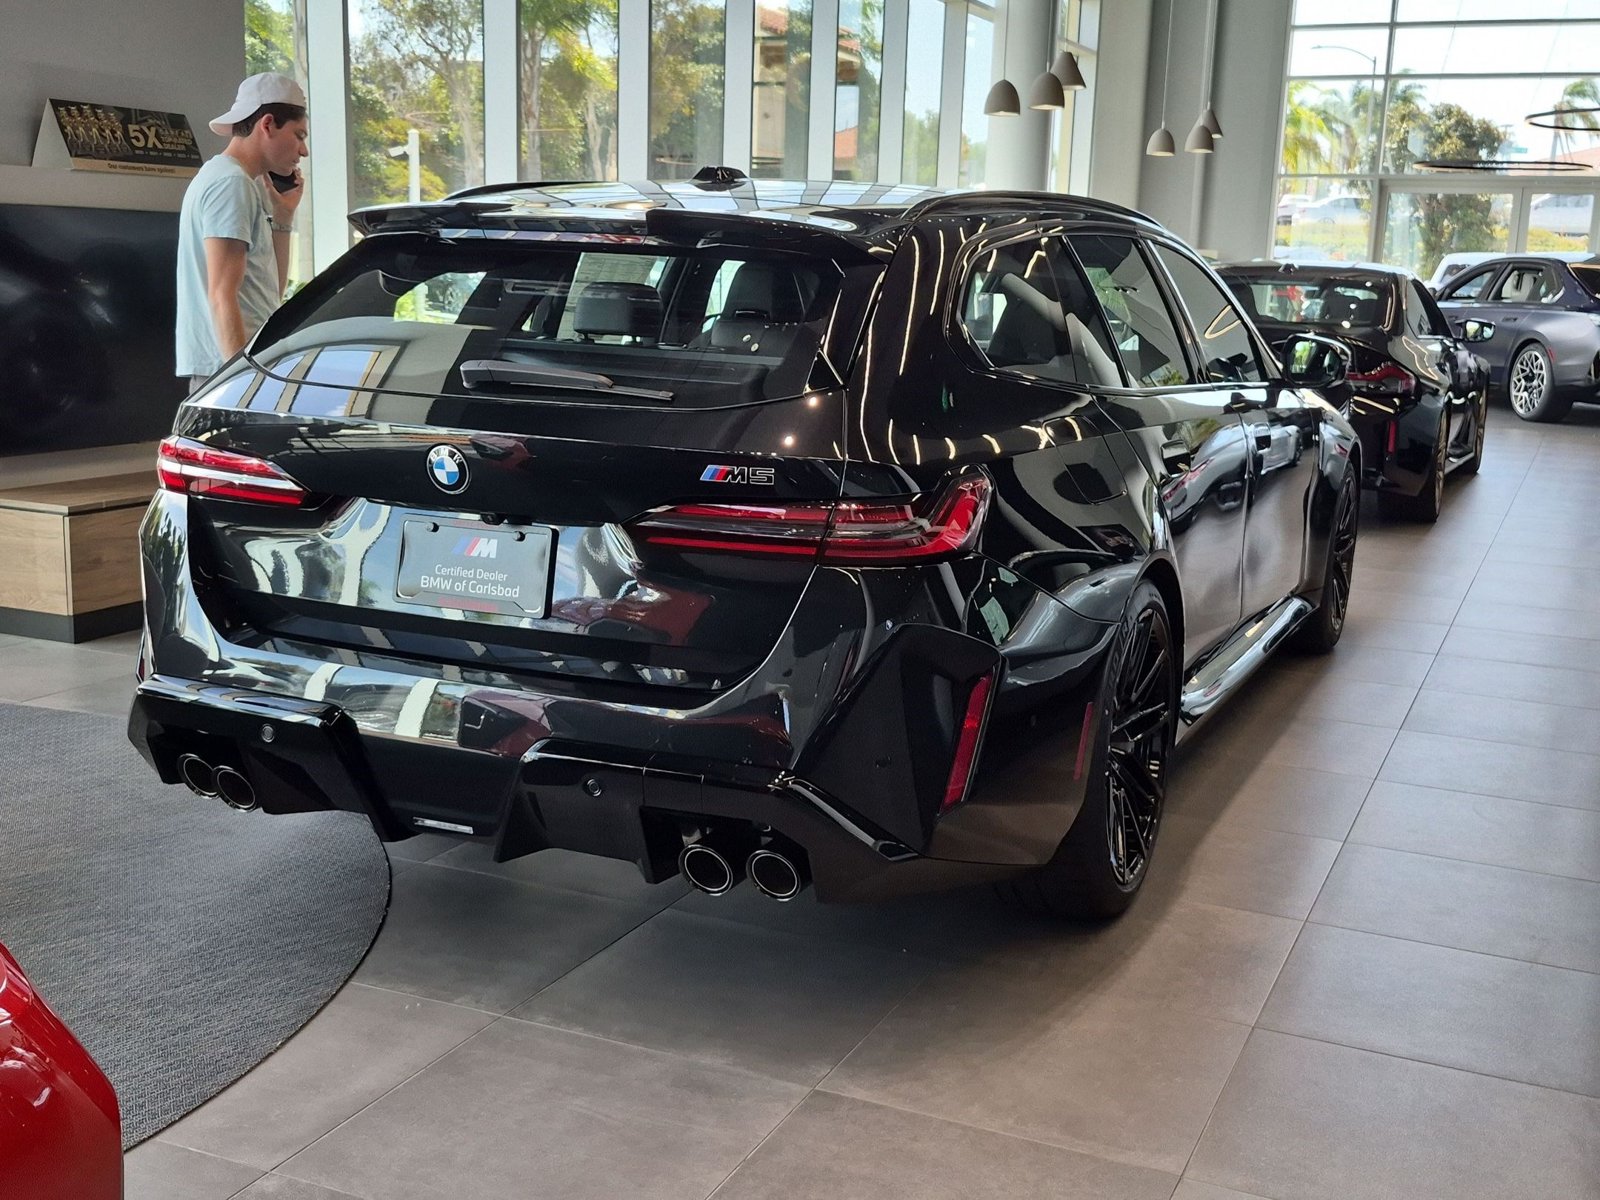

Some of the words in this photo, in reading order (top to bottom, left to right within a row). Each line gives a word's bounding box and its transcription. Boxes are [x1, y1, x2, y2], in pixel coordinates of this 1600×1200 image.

[128, 124, 164, 149] 5X
[720, 465, 774, 485] M5
[435, 564, 474, 578] Certified
[476, 568, 508, 582] Dealer
[420, 575, 452, 590] BMW
[454, 580, 467, 592] of
[468, 580, 520, 598] Carlsbad
